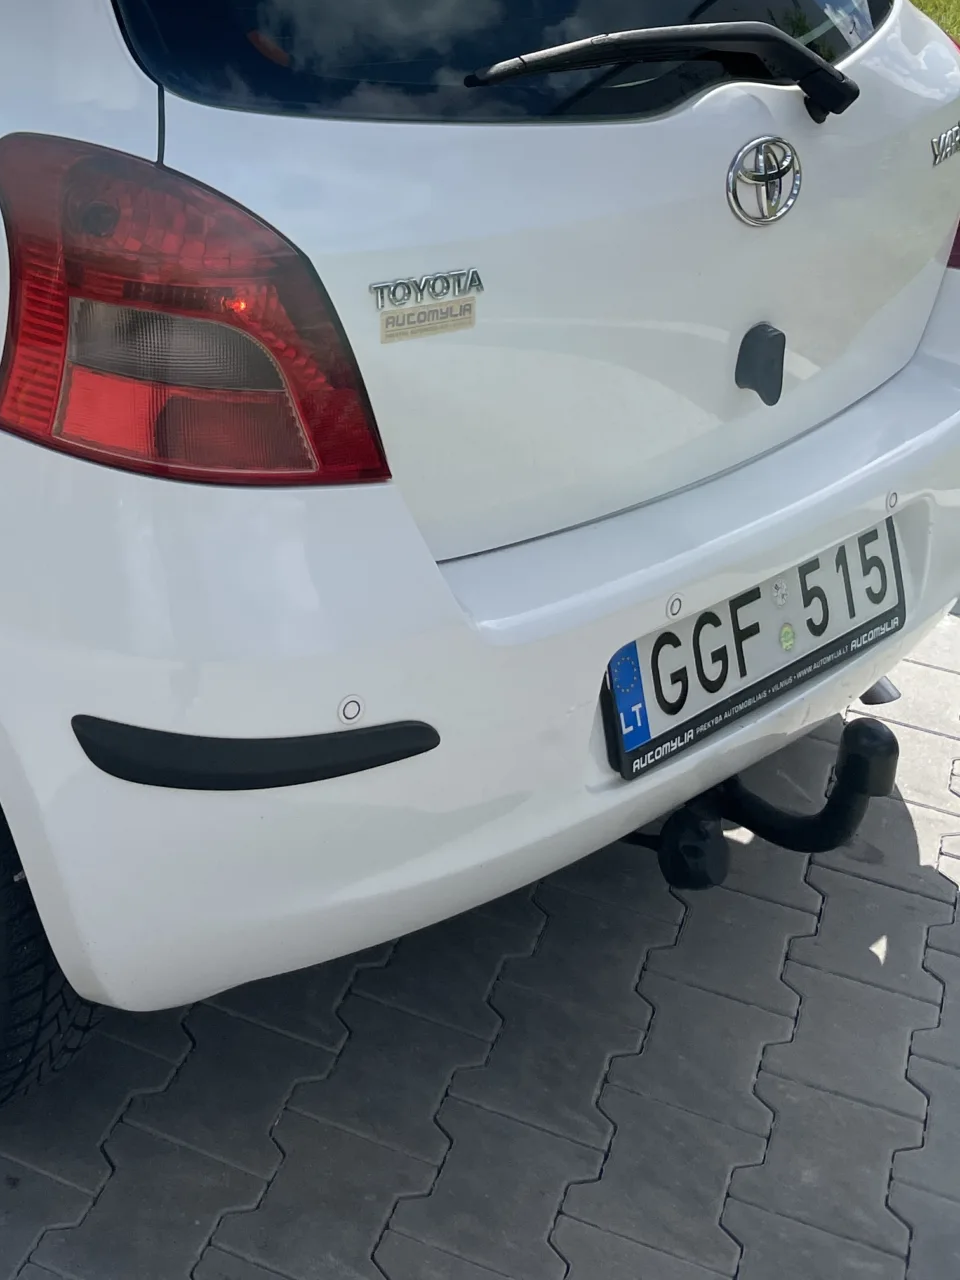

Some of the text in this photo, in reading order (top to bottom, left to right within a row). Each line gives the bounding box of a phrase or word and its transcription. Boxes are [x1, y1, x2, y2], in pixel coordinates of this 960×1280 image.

[369, 267, 484, 310] TOYOTA
[651, 528, 888, 716] GGF 515
[619, 703, 643, 735] LT
[695, 714, 723, 735] PREKYBA
[723, 689, 768, 720] AUTOMOBILIAIS
[771, 675, 793, 693] VILNIUS
